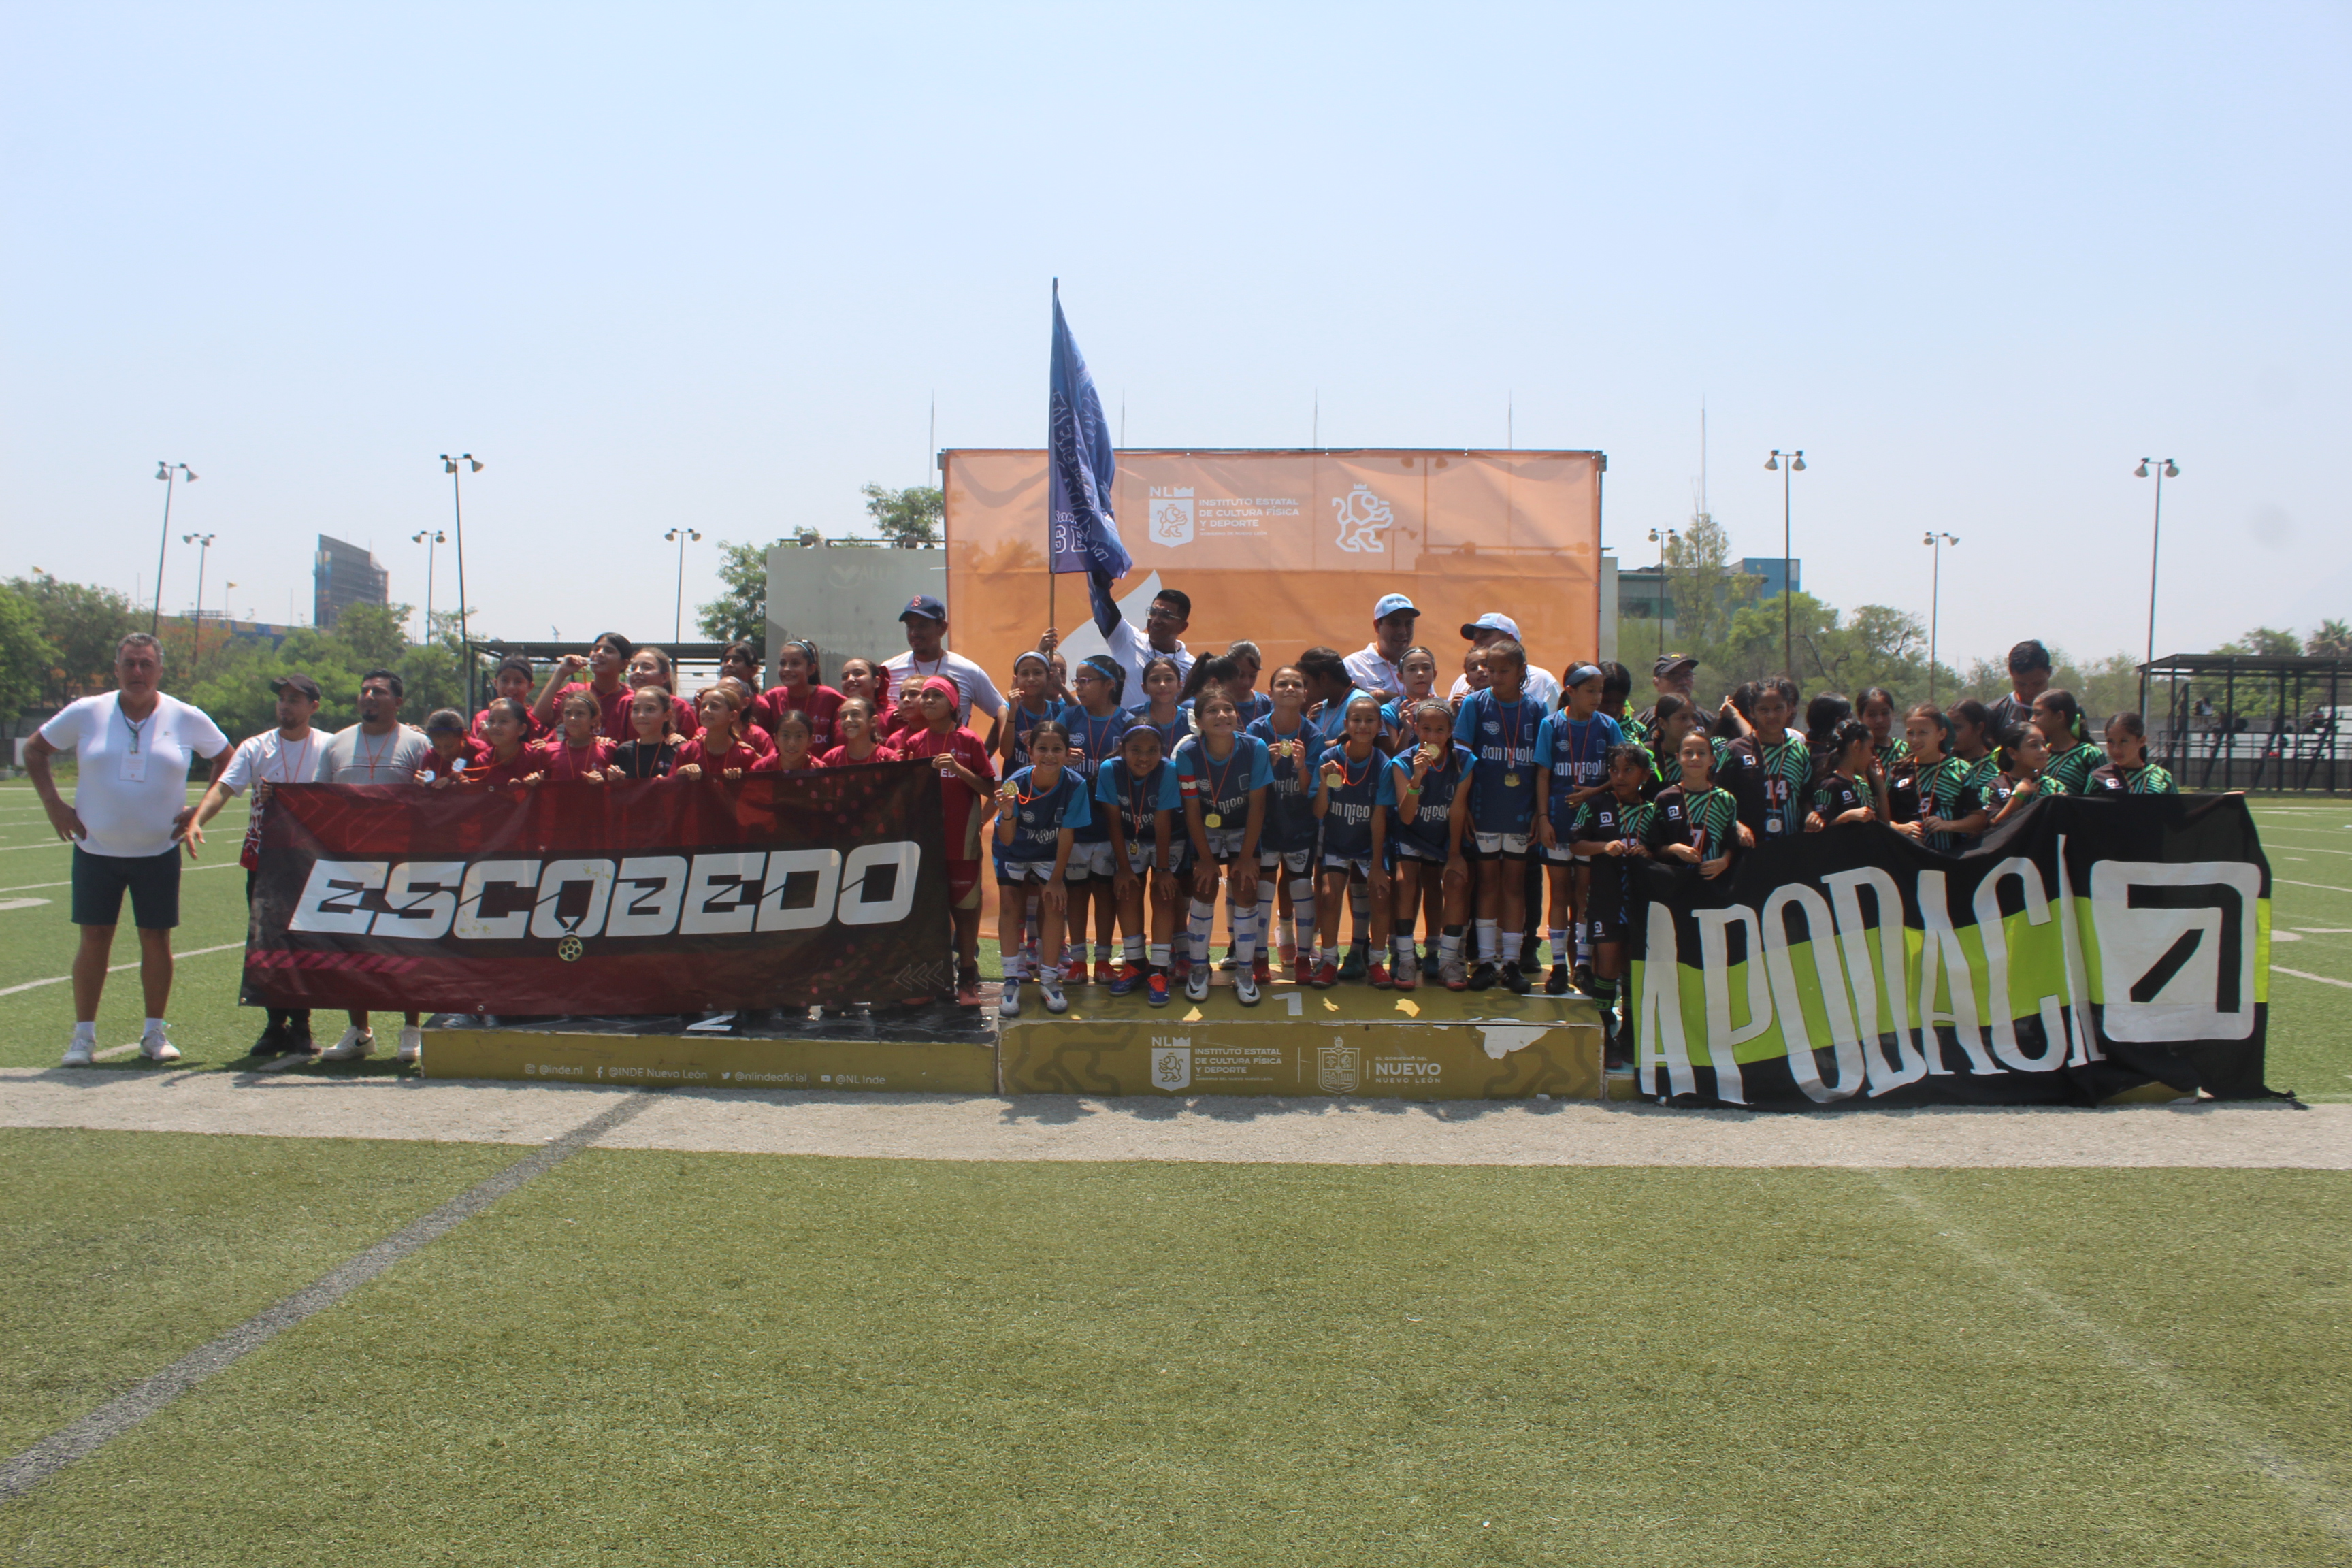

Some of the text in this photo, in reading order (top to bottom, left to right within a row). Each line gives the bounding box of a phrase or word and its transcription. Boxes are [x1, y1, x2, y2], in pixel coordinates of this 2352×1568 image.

[1199, 497, 1299, 506] INSTITUTO ESTATAL
[1215, 508, 1263, 517] CULTURA
[1266, 506, 1299, 516] FÍSICA
[1210, 519, 1259, 527] DEPORTE
[1764, 779, 1788, 800] 14
[1690, 829, 1703, 849] 7
[288, 841, 921, 940] ESCOBEDO
[1271, 992, 1303, 1016] 1
[1253, 1056, 1282, 1064] FÍSICA
[539, 1064, 583, 1075] @inde.nl
[608, 1066, 644, 1077] @INDE
[647, 1068, 680, 1078] Nuevo
[683, 1069, 708, 1079] León
[1375, 1063, 1441, 1075] NUEVO
[734, 1071, 808, 1083] @nlindeoficial
[836, 1075, 886, 1085] @NL Inde
